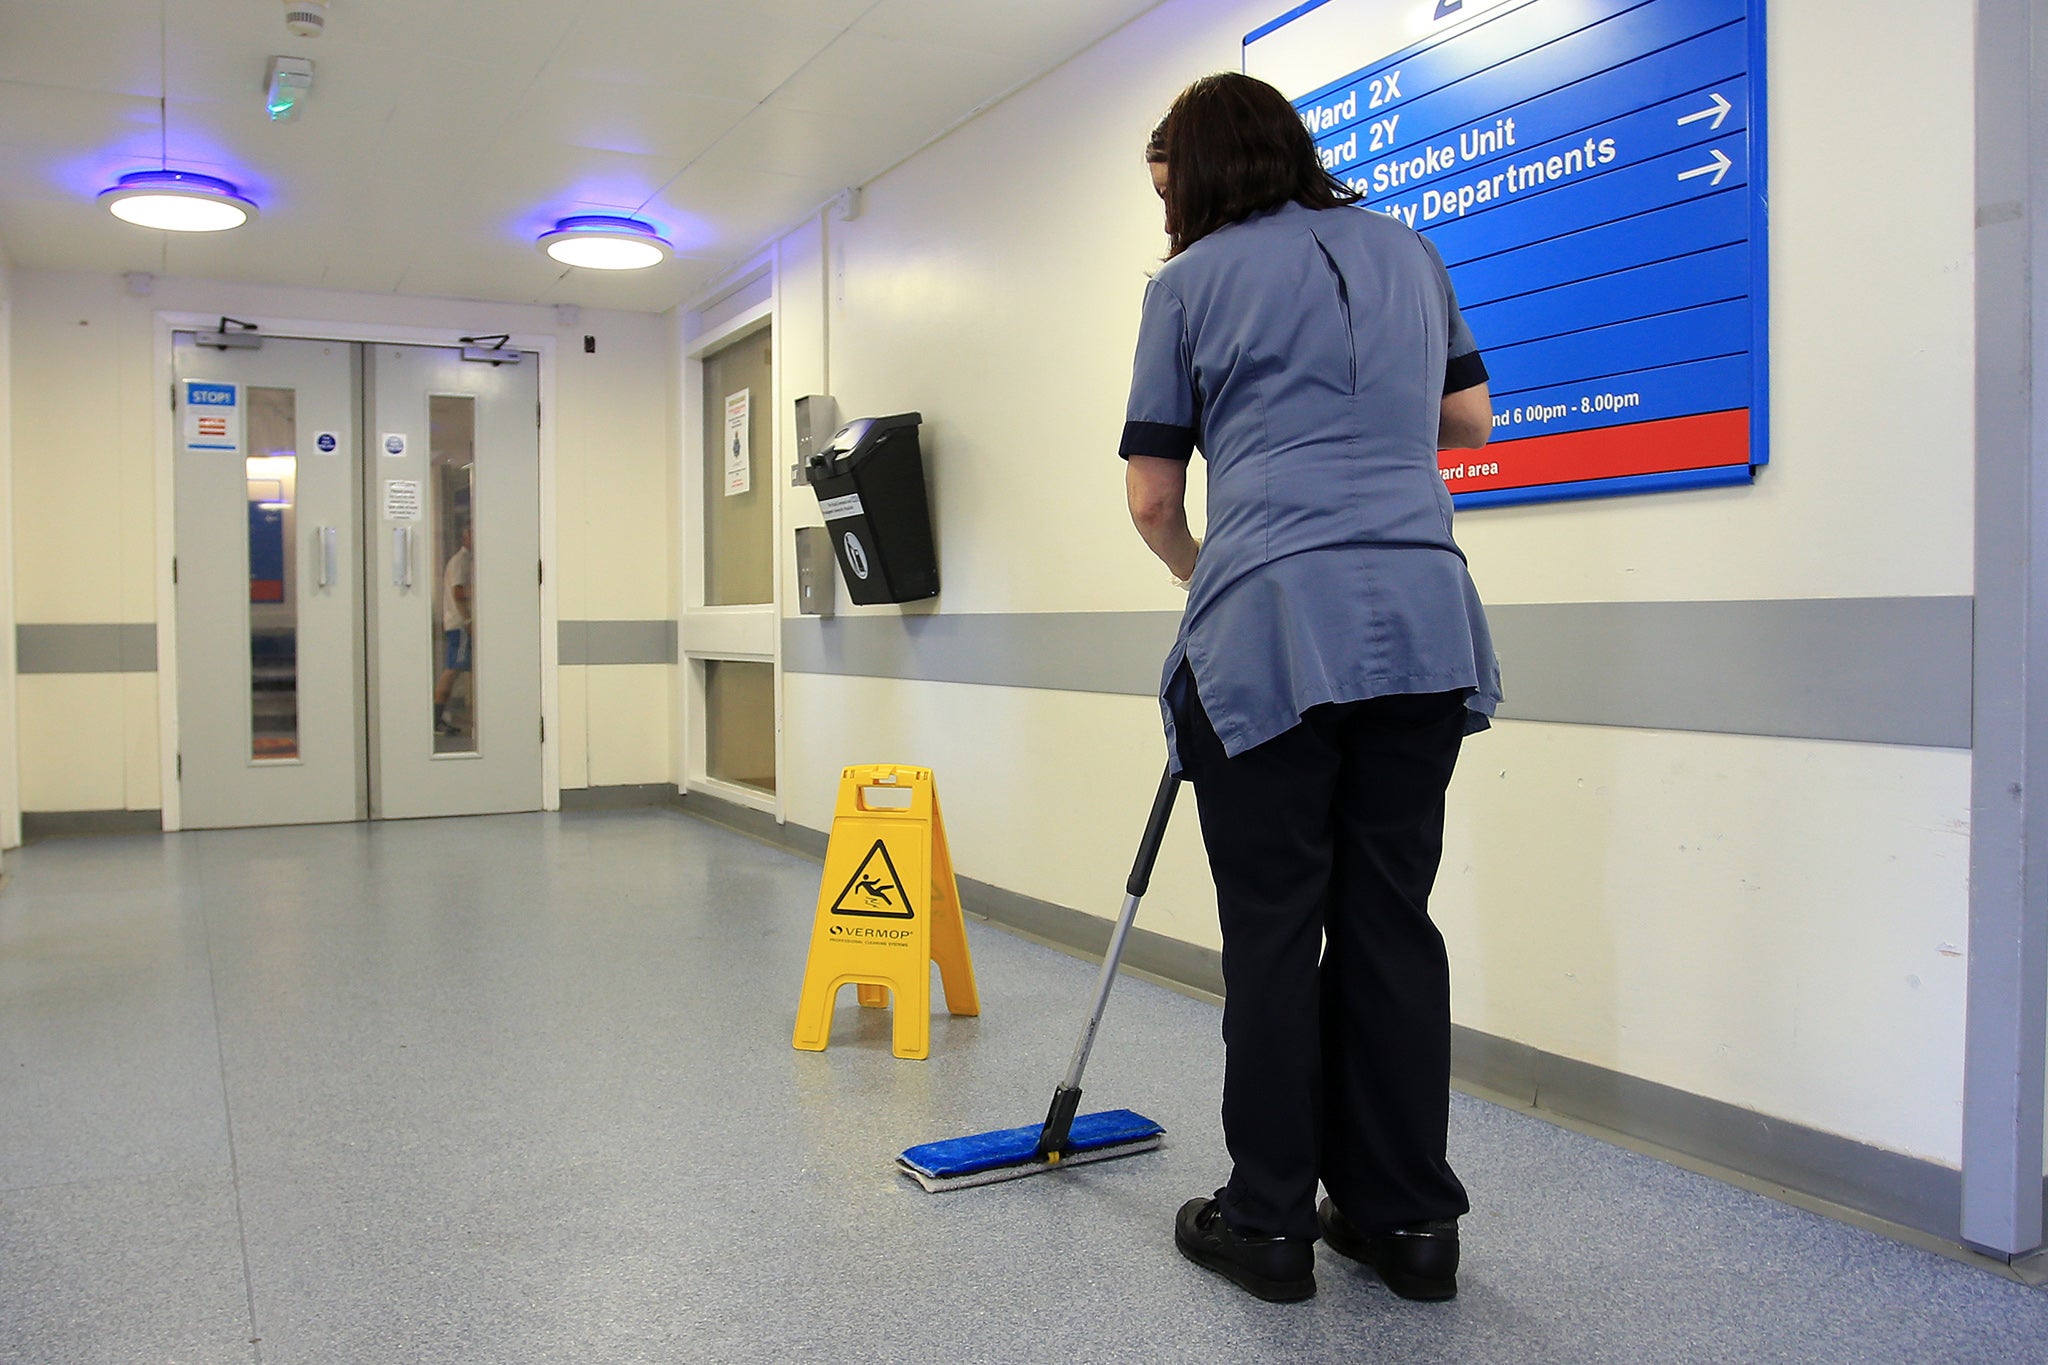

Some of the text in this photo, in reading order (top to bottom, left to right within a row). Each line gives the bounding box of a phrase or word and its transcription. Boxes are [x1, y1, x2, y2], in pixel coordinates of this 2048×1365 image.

[1301, 70, 1401, 134] Ward 2X
[1369, 114, 1400, 152] 2Y
[1373, 145, 1455, 193] Stroke
[1460, 117, 1516, 162] Unit
[1423, 137, 1616, 221] Departments
[1492, 410, 1510, 427] nd
[1581, 392, 1640, 413] 8.00pm
[1467, 462, 1499, 477] area
[845, 927, 910, 939] VERMOP
